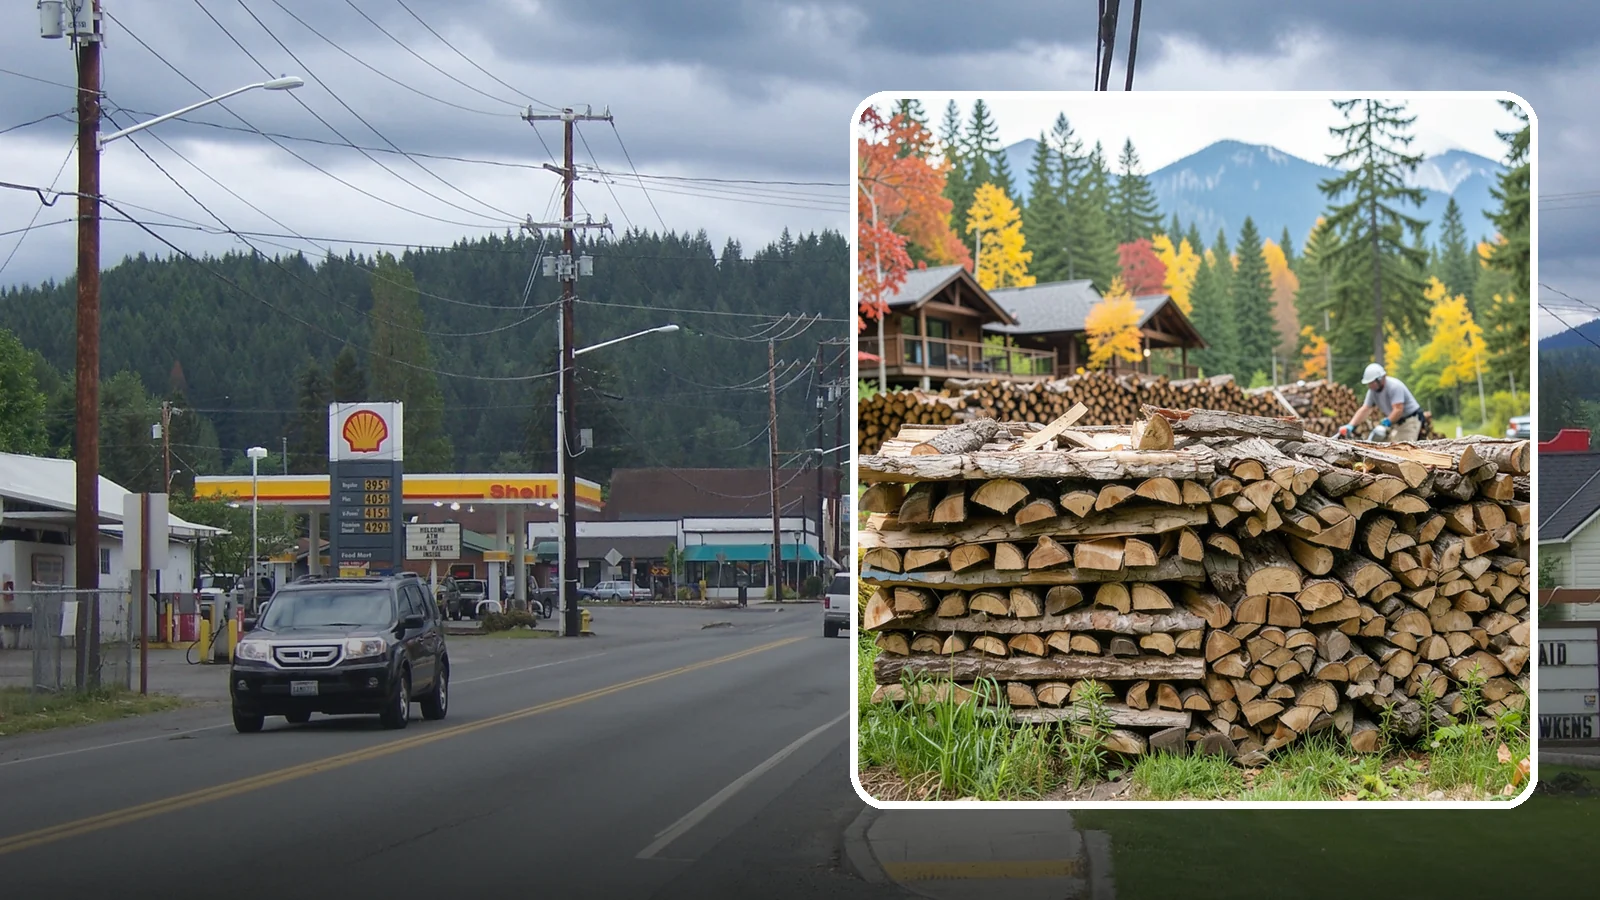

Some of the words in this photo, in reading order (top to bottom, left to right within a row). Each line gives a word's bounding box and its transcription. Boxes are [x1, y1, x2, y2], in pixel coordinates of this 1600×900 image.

[366, 480, 383, 490] 395
[490, 484, 547, 498] Shell
[366, 494, 383, 504] 405
[366, 508, 383, 518] 415
[366, 522, 383, 532] 429
